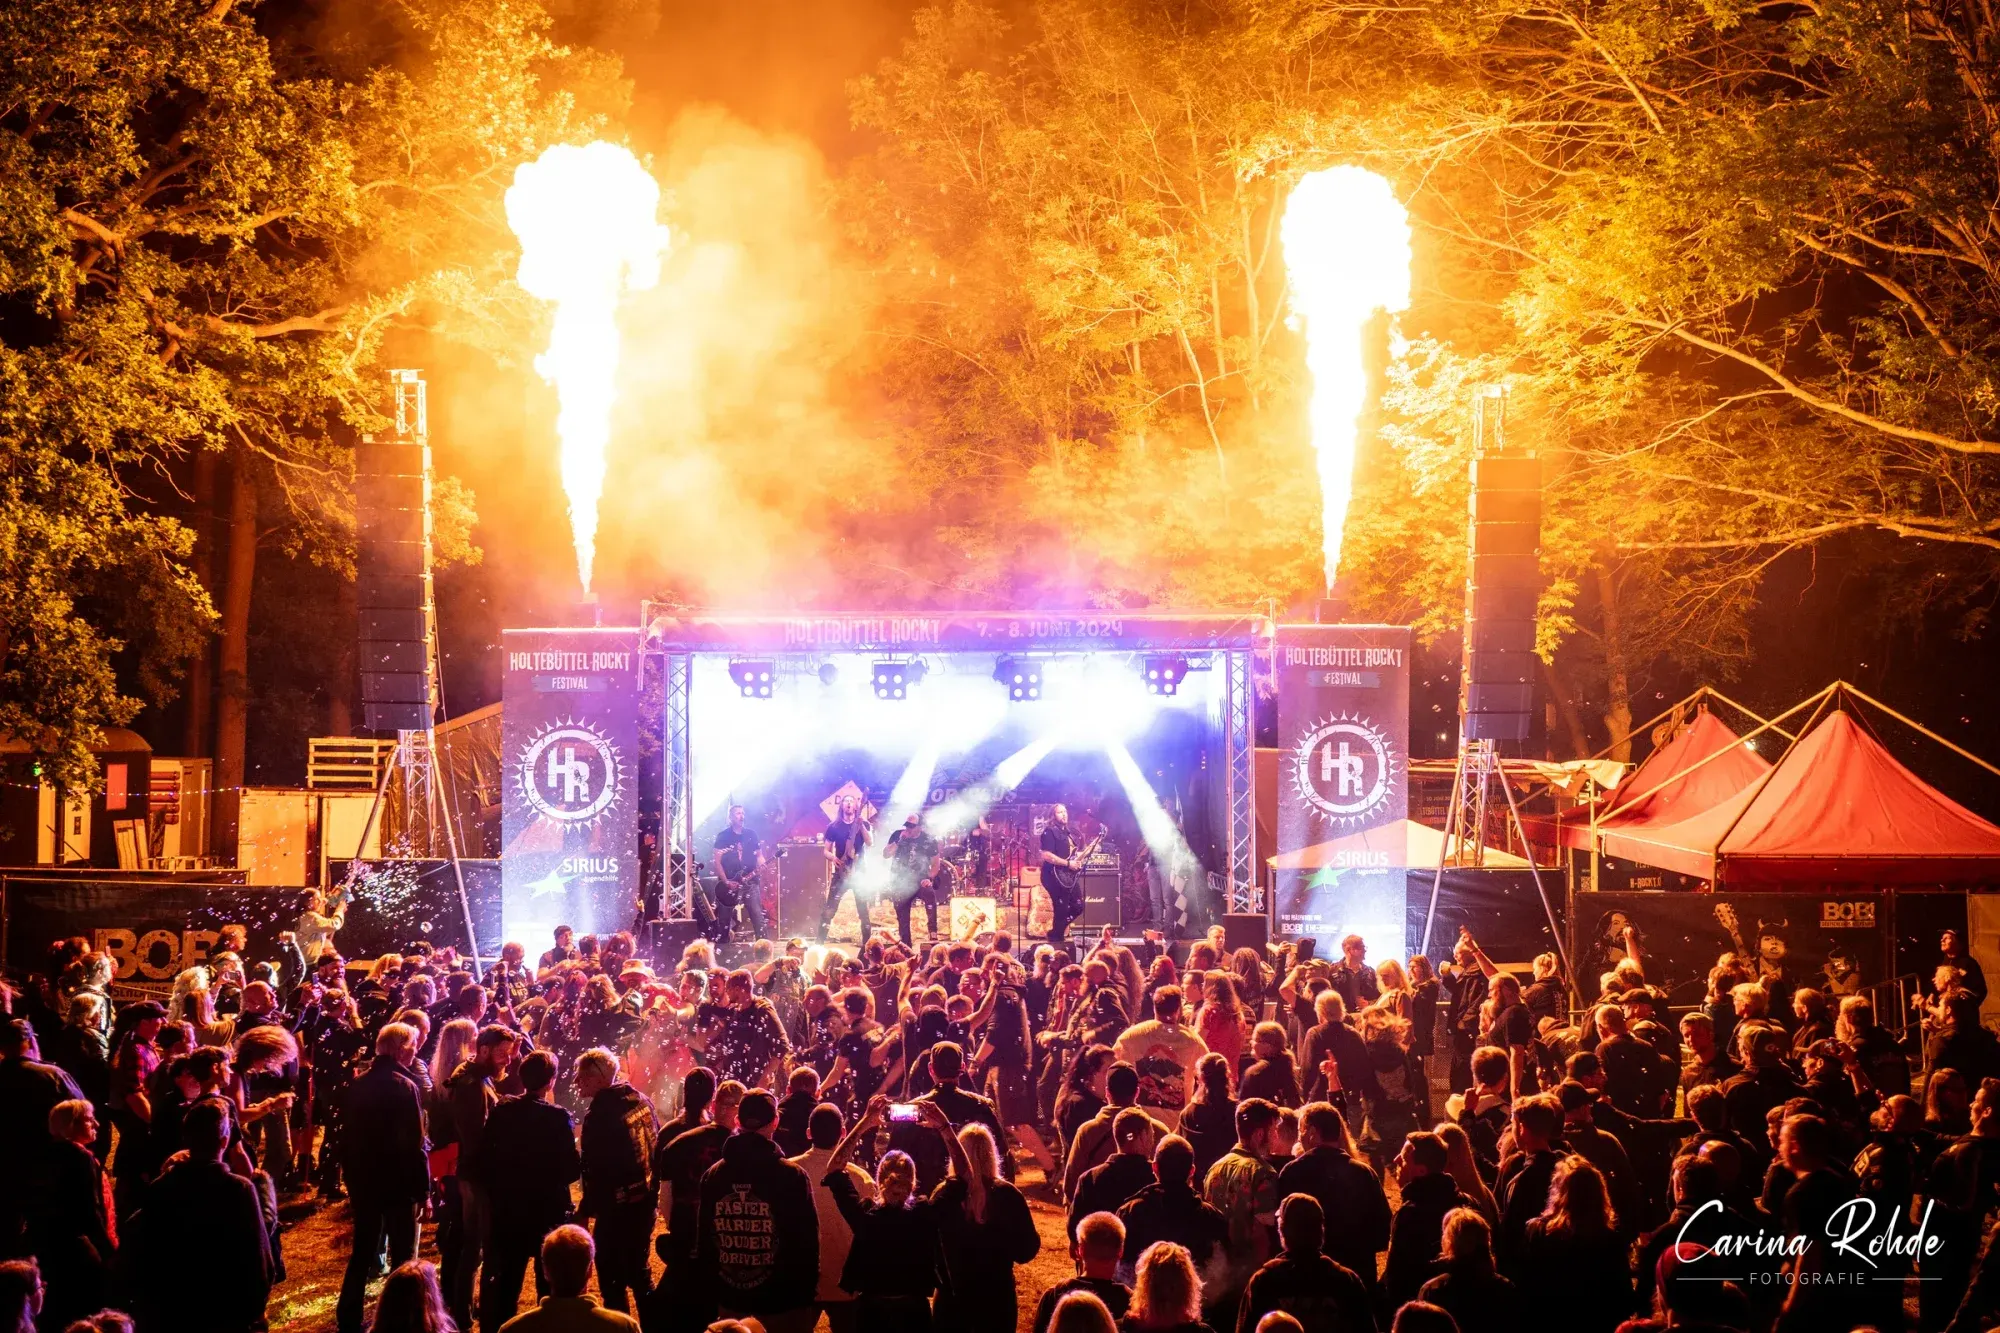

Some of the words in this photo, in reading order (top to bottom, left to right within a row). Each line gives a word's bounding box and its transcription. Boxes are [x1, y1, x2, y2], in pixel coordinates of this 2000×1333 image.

[785, 616, 887, 644] HOLTEBÜTTEL
[891, 618, 941, 644] ROCKT
[977, 621, 992, 637] 7.
[1009, 621, 1024, 637] 8.
[1028, 621, 1072, 637] JUNI
[1076, 619, 1123, 637] 2024
[510, 650, 589, 671] HOLTEBÜTTEL
[592, 652, 631, 671] ROCKT
[1285, 645, 1362, 666] HOLTEBÜTTEL
[1365, 649, 1403, 667] ROCKT
[552, 676, 588, 690] FESTIVAL
[1326, 672, 1361, 685] FESTIVAL
[563, 858, 619, 873] SIRIUS
[1336, 851, 1389, 867] SIRIUS
[1823, 901, 1875, 919] BOB!
[715, 1201, 770, 1217] FASTER
[713, 1218, 773, 1233] HARDER
